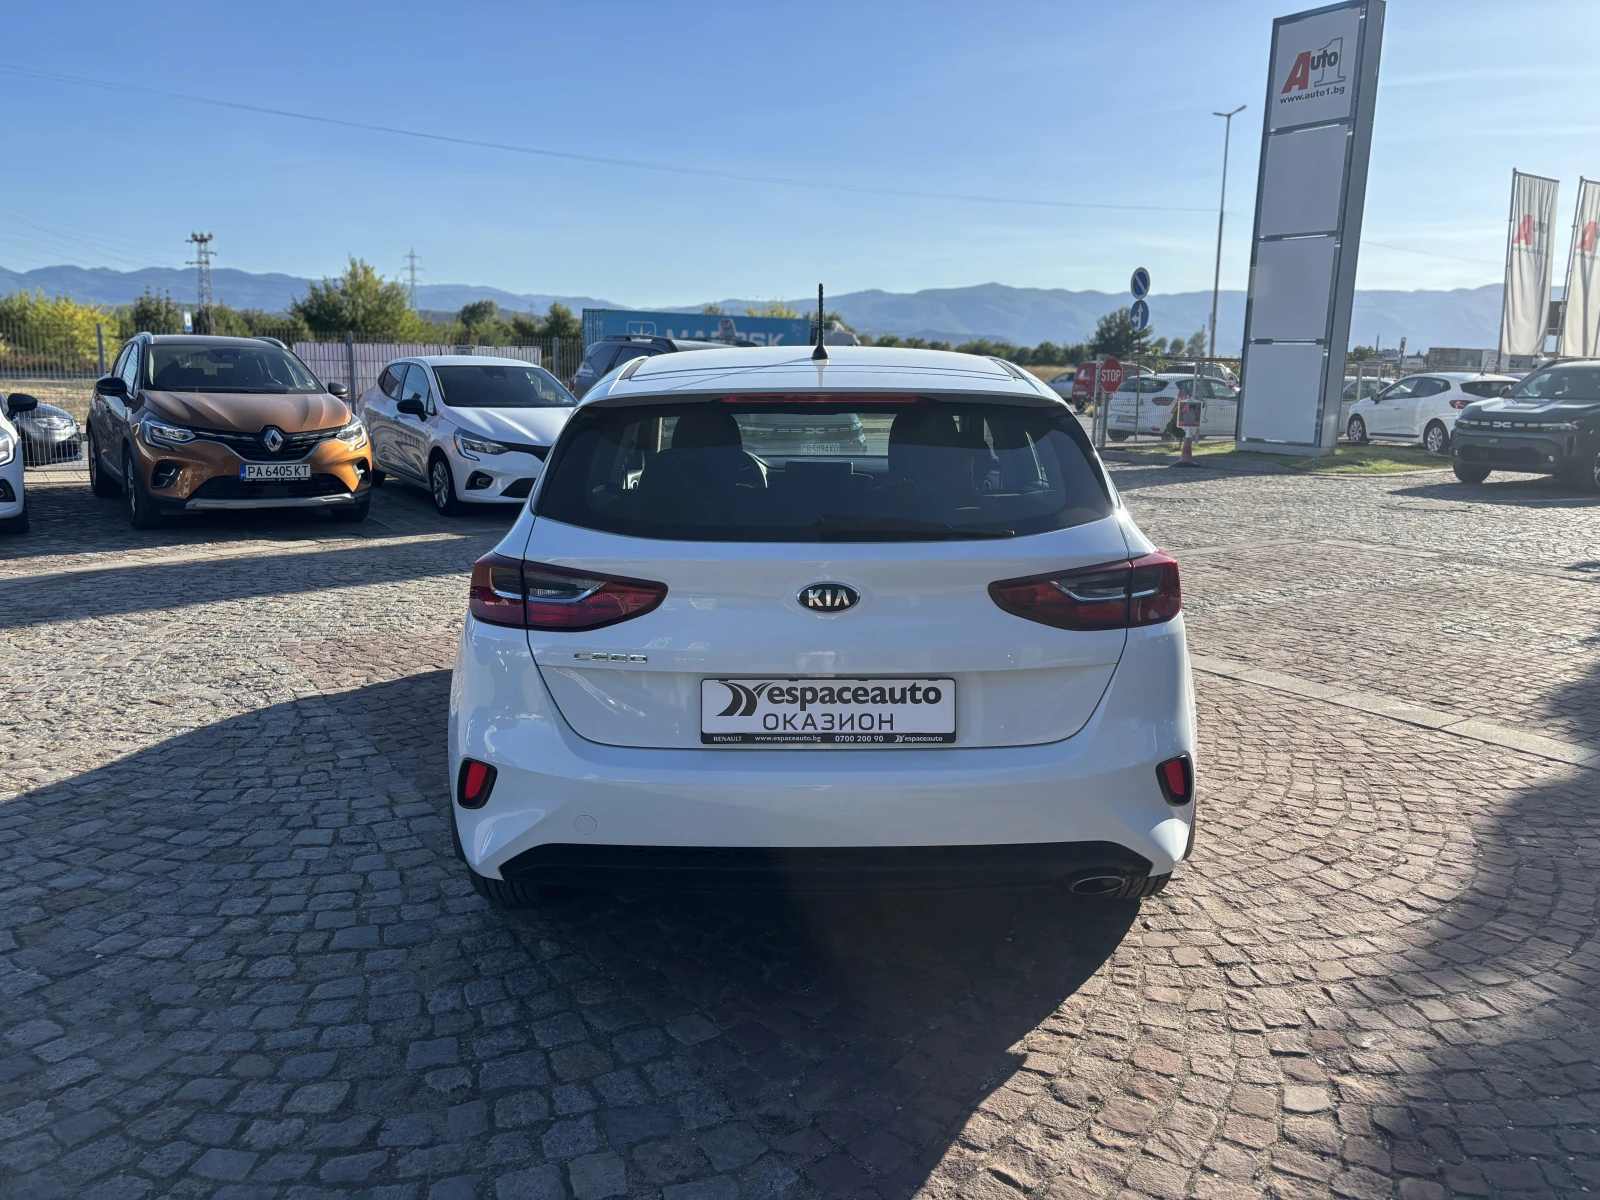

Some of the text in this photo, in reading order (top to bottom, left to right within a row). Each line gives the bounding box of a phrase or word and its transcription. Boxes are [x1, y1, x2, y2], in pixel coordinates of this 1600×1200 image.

[1280, 86, 1345, 104] www.auto1.bg
[1101, 369, 1121, 382] STOP
[808, 589, 850, 607] KIA
[767, 682, 942, 711] espaceauto
[762, 713, 894, 731] ОКАЗИОН
[755, 735, 821, 743] www.espaceauto.bg
[904, 735, 943, 743] espaceauto
